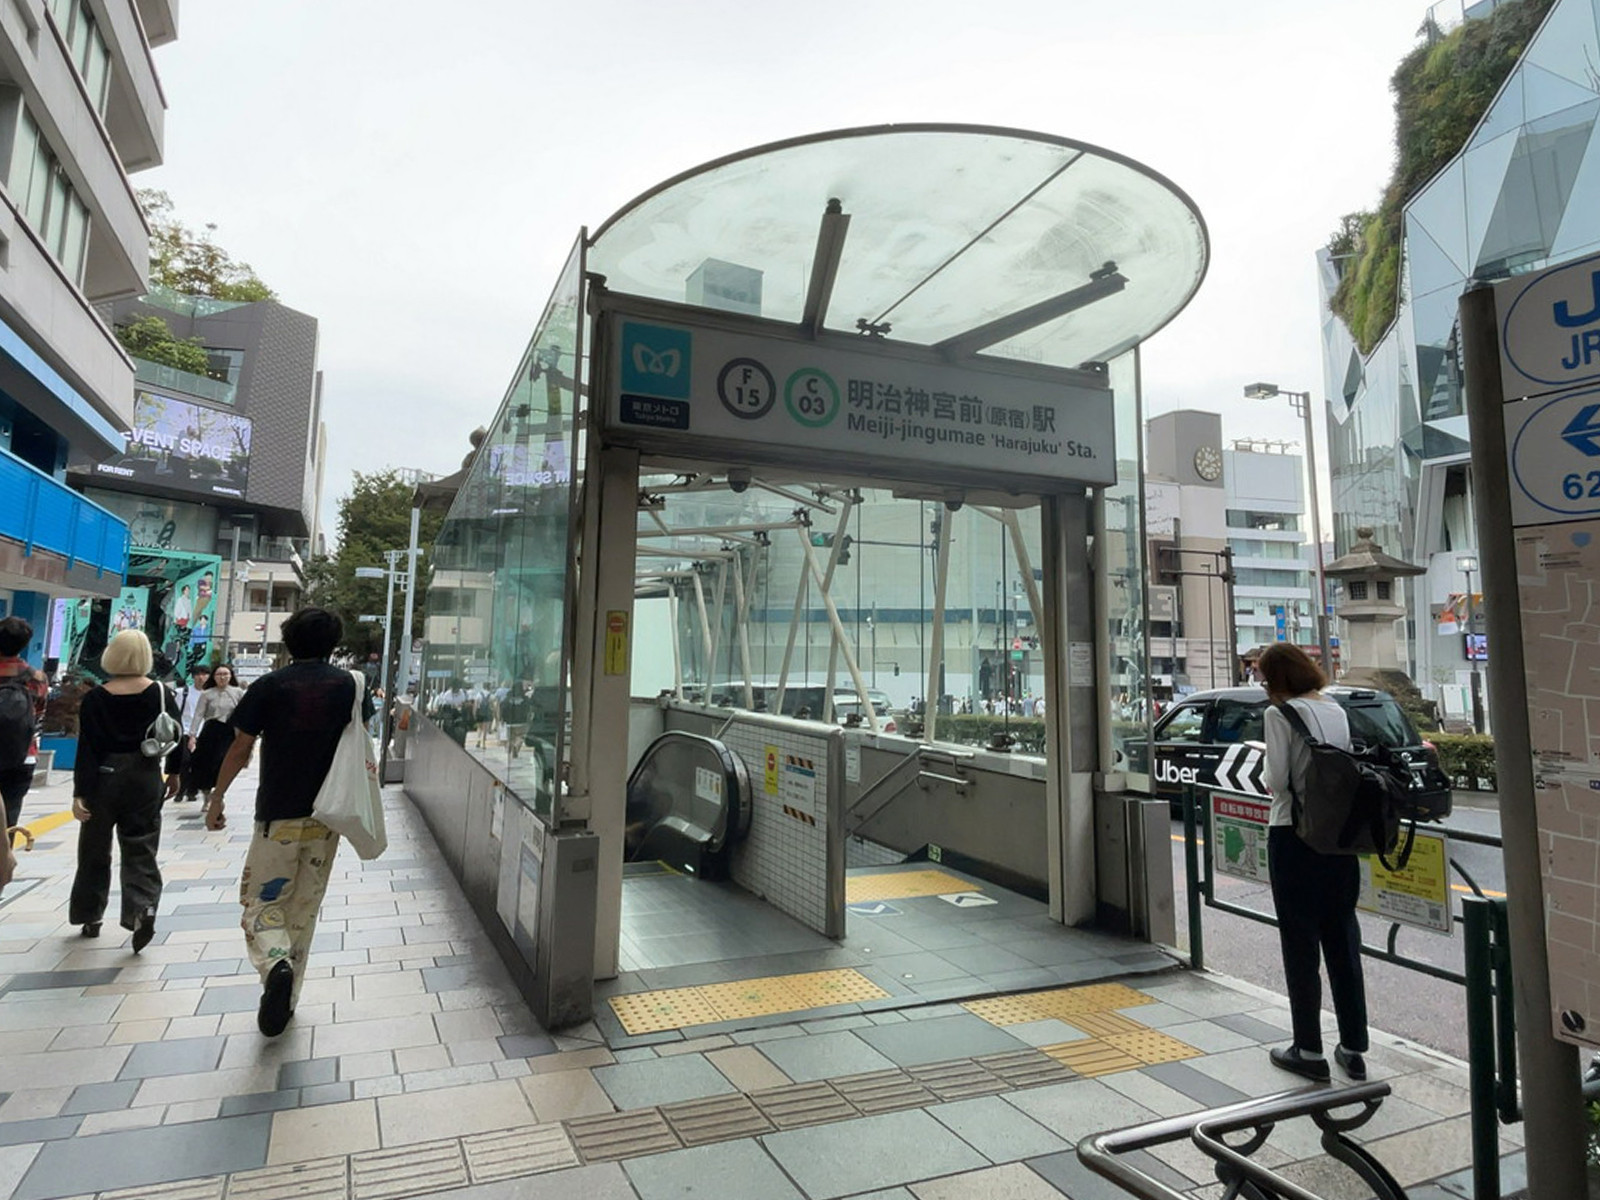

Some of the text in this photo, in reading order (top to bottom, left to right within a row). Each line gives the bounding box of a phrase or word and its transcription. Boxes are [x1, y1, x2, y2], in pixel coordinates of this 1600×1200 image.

[1561, 329, 1600, 370] JR
[742, 368, 752, 385] F
[806, 378, 819, 394] C
[736, 387, 760, 407] 15
[799, 396, 825, 415] 03
[847, 412, 986, 446] Meiji-jingumae
[1067, 440, 1097, 459] Sta.
[180, 438, 232, 462] SPACE
[1154, 758, 1199, 783] Uber
